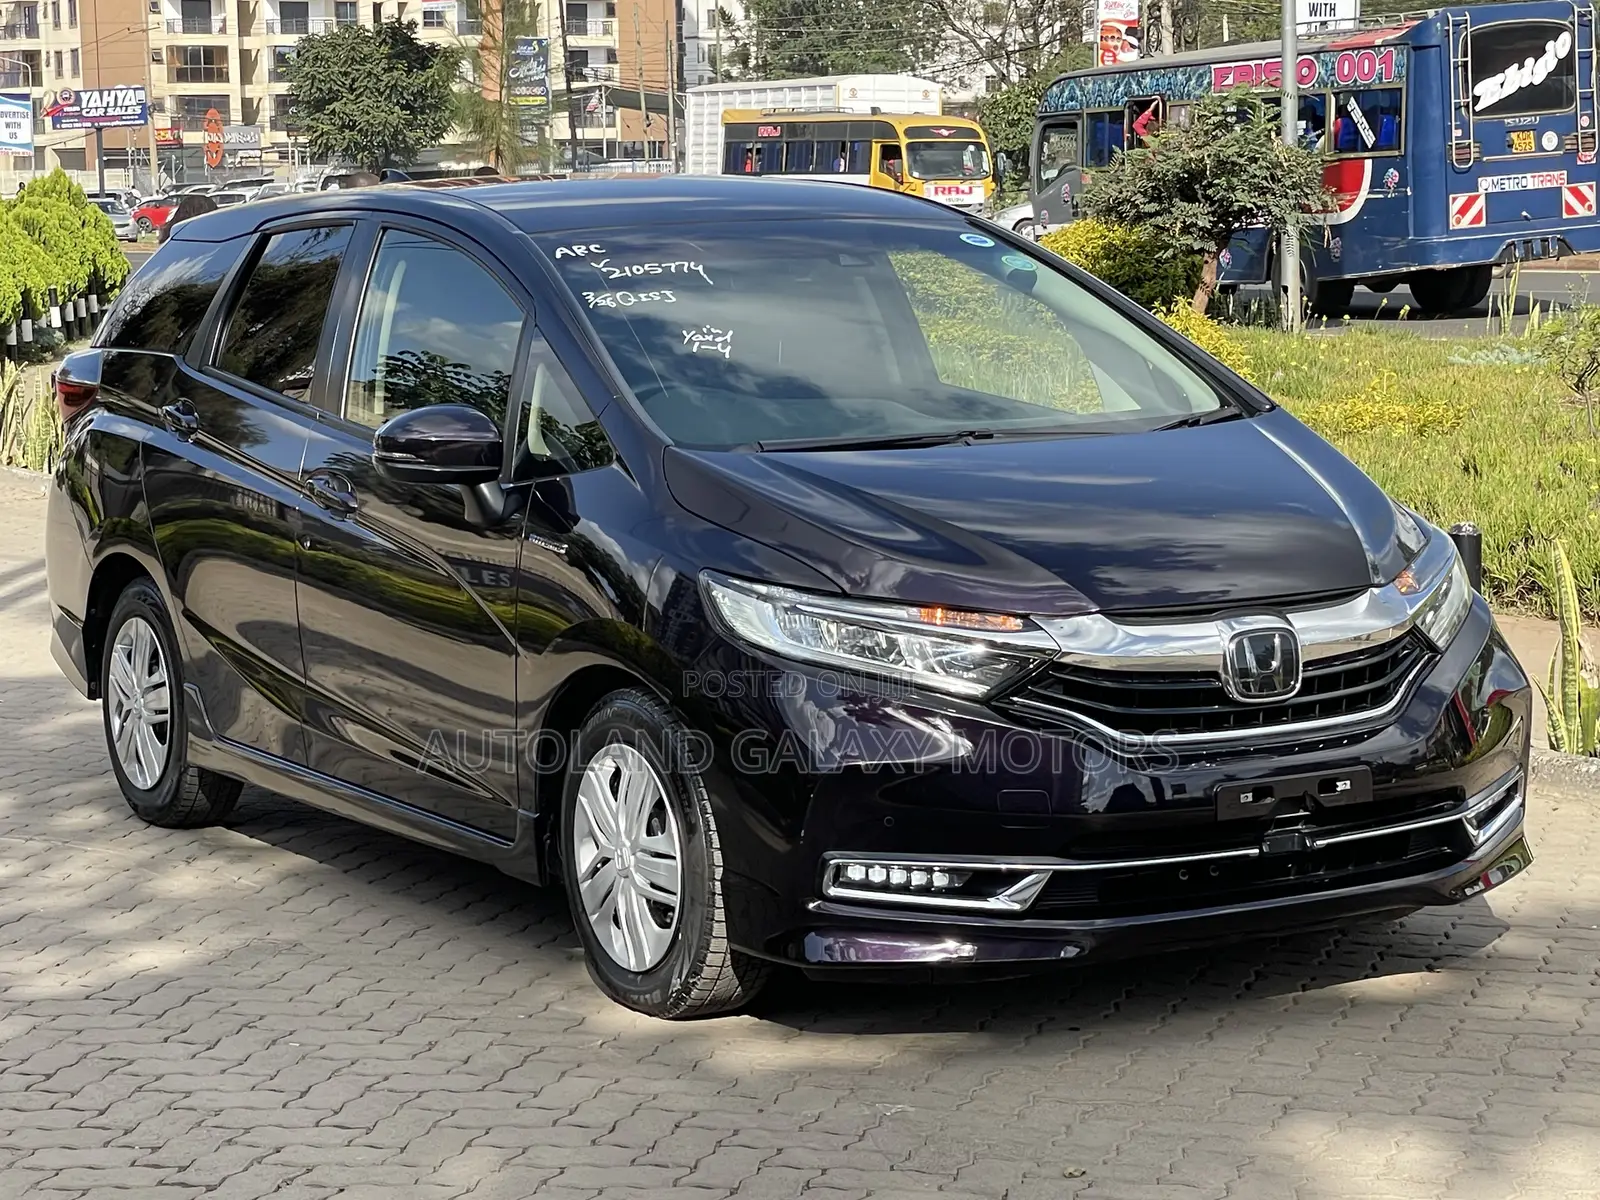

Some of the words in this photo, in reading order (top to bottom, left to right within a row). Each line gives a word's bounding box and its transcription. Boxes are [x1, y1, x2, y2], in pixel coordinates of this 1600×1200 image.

[1308, 2, 1336, 17] WITH
[1336, 48, 1395, 84] 001
[80, 90, 137, 108] YAHYA
[0, 111, 29, 119] DVERTISE
[82, 108, 104, 117] CAR
[106, 105, 142, 116] SALES
[1504, 116, 1540, 127] ISUZU
[757, 125, 781, 137] RAJ
[1491, 176, 1528, 191] METRO
[1530, 172, 1566, 187] TRANS
[933, 186, 973, 196] RAJ
